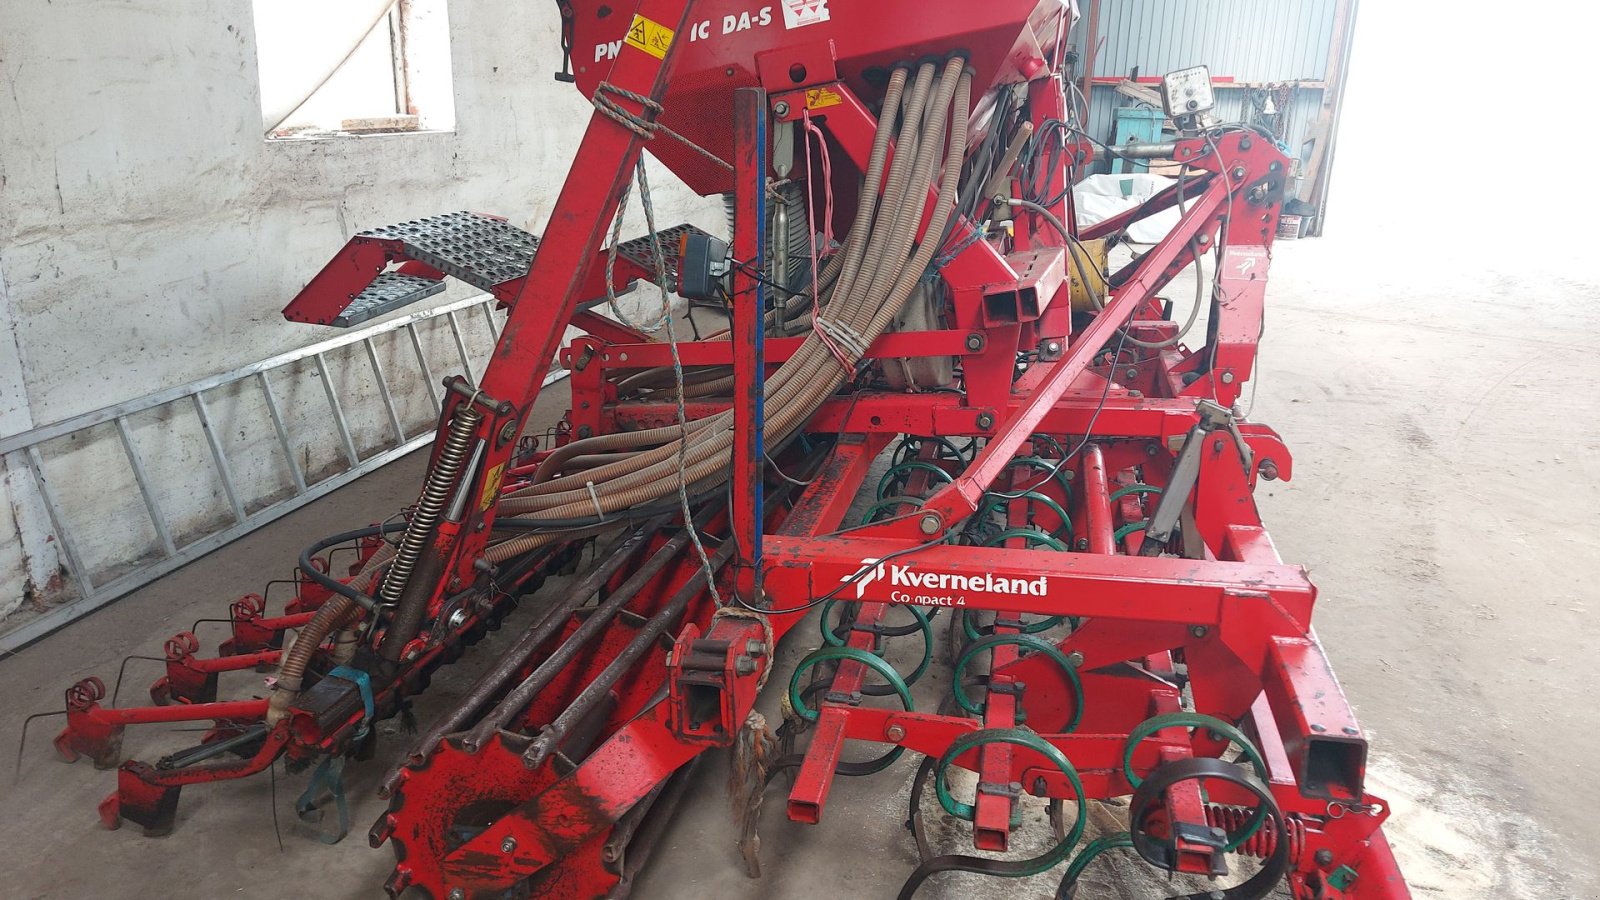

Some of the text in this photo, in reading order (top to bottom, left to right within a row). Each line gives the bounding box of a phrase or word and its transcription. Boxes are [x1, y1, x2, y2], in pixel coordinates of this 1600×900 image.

[722, 6, 772, 35] DA-S
[891, 564, 1048, 596] Kverneland
[956, 596, 966, 605] 4
